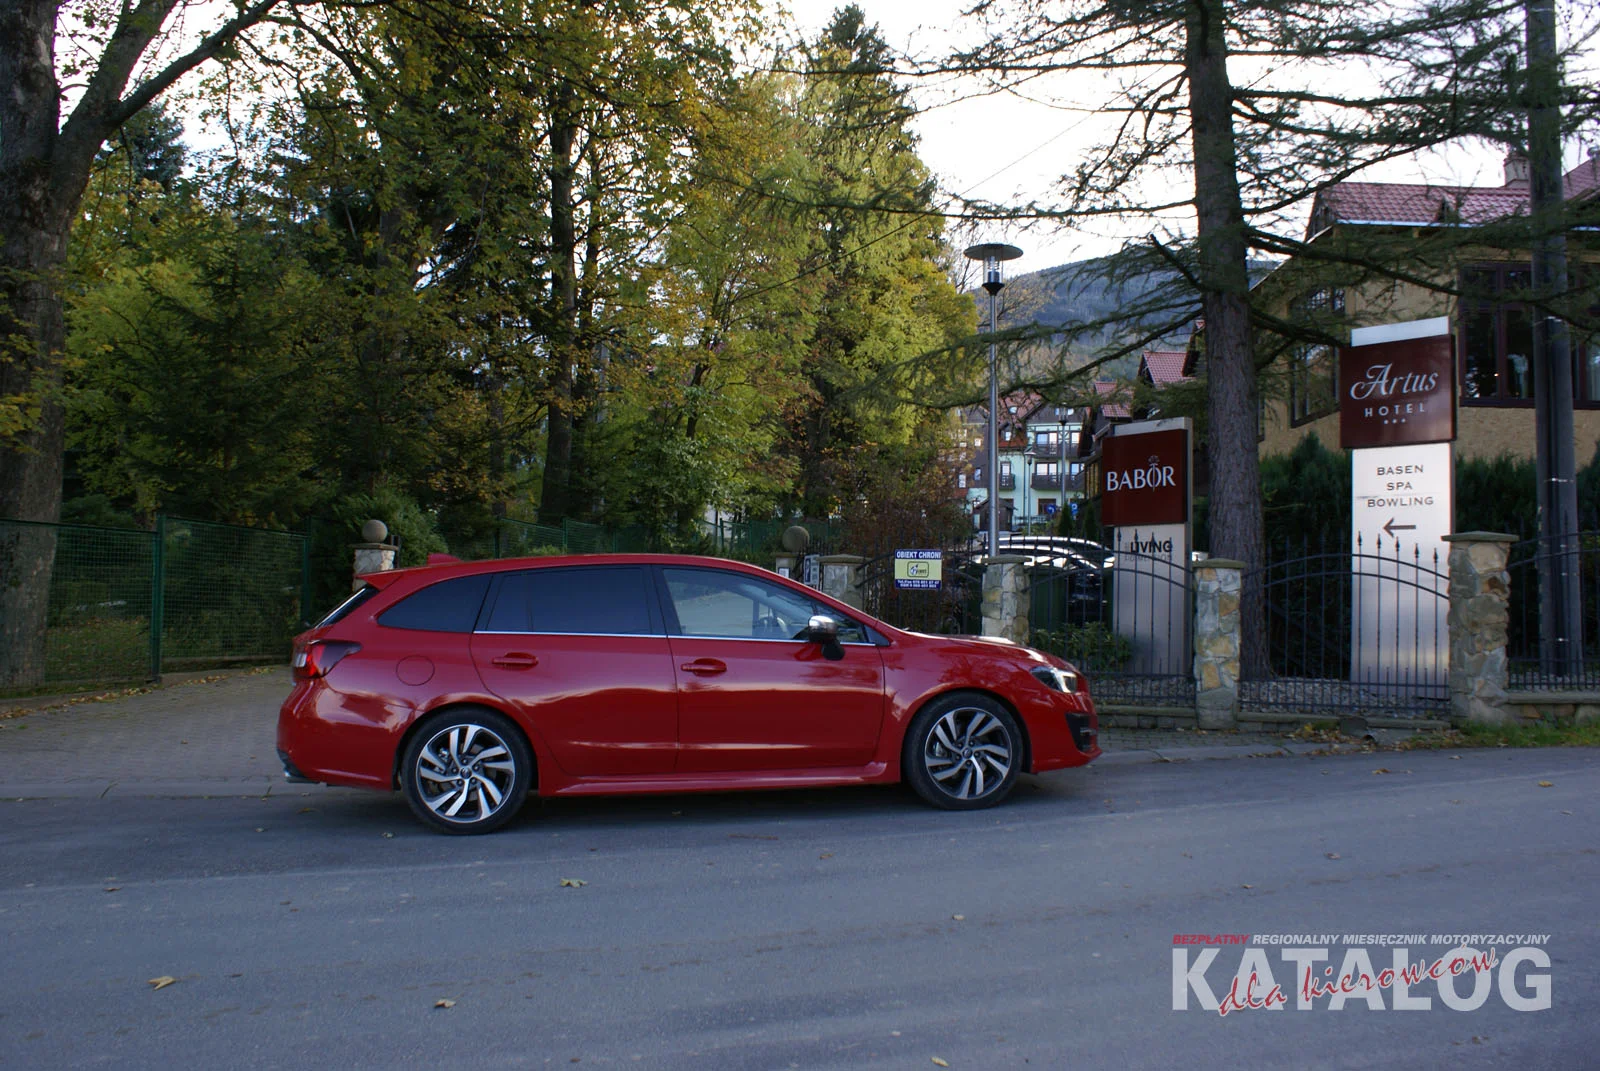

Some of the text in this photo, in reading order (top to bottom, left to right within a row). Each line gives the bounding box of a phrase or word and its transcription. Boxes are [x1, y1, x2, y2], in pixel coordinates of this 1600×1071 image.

[1351, 363, 1439, 400] Artus
[1364, 403, 1426, 418] HOTEL
[1376, 464, 1424, 476] BASEN
[1106, 465, 1176, 491] BABOR
[1386, 482, 1413, 491] SPA
[1367, 496, 1434, 508] BOWLING
[896, 551, 917, 559] OBIEKT
